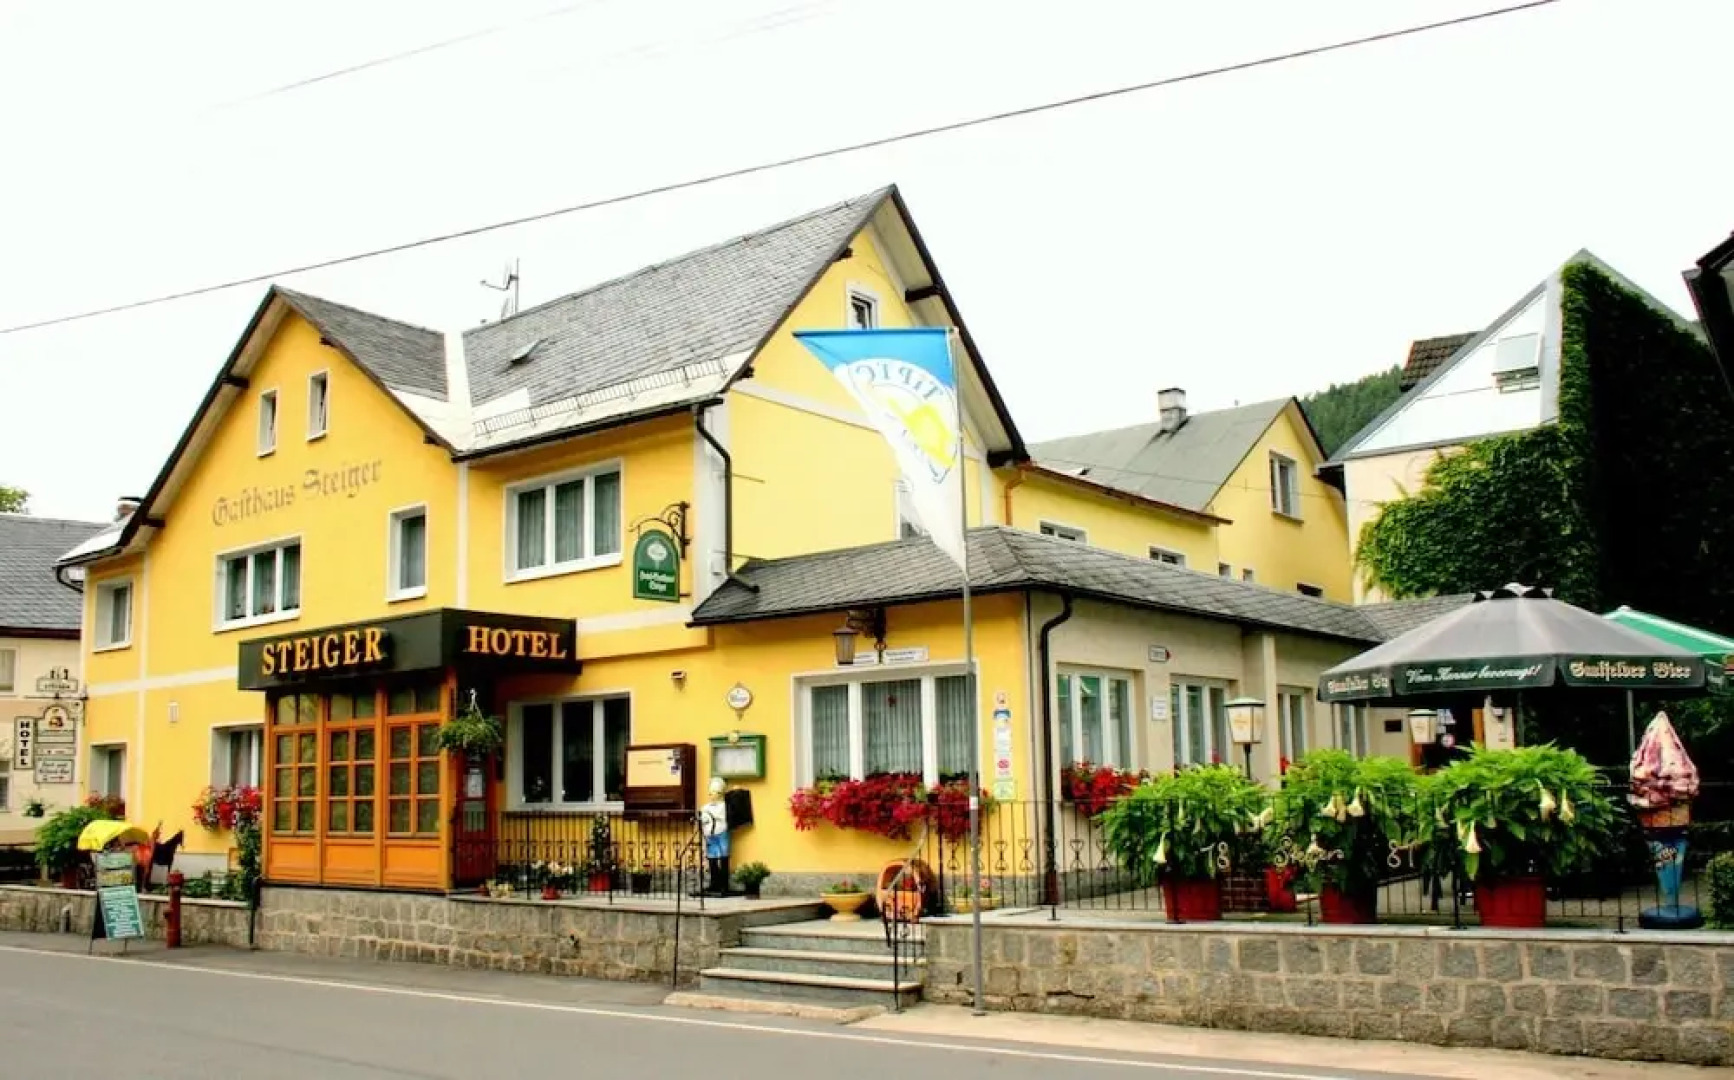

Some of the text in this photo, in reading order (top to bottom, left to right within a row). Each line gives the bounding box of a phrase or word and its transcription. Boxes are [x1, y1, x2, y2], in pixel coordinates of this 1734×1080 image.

[212, 459, 382, 526] Gasthaus Steiger
[261, 627, 387, 676] STEIGER
[466, 625, 568, 660] HOTEL
[20, 720, 31, 766] HOTEL
